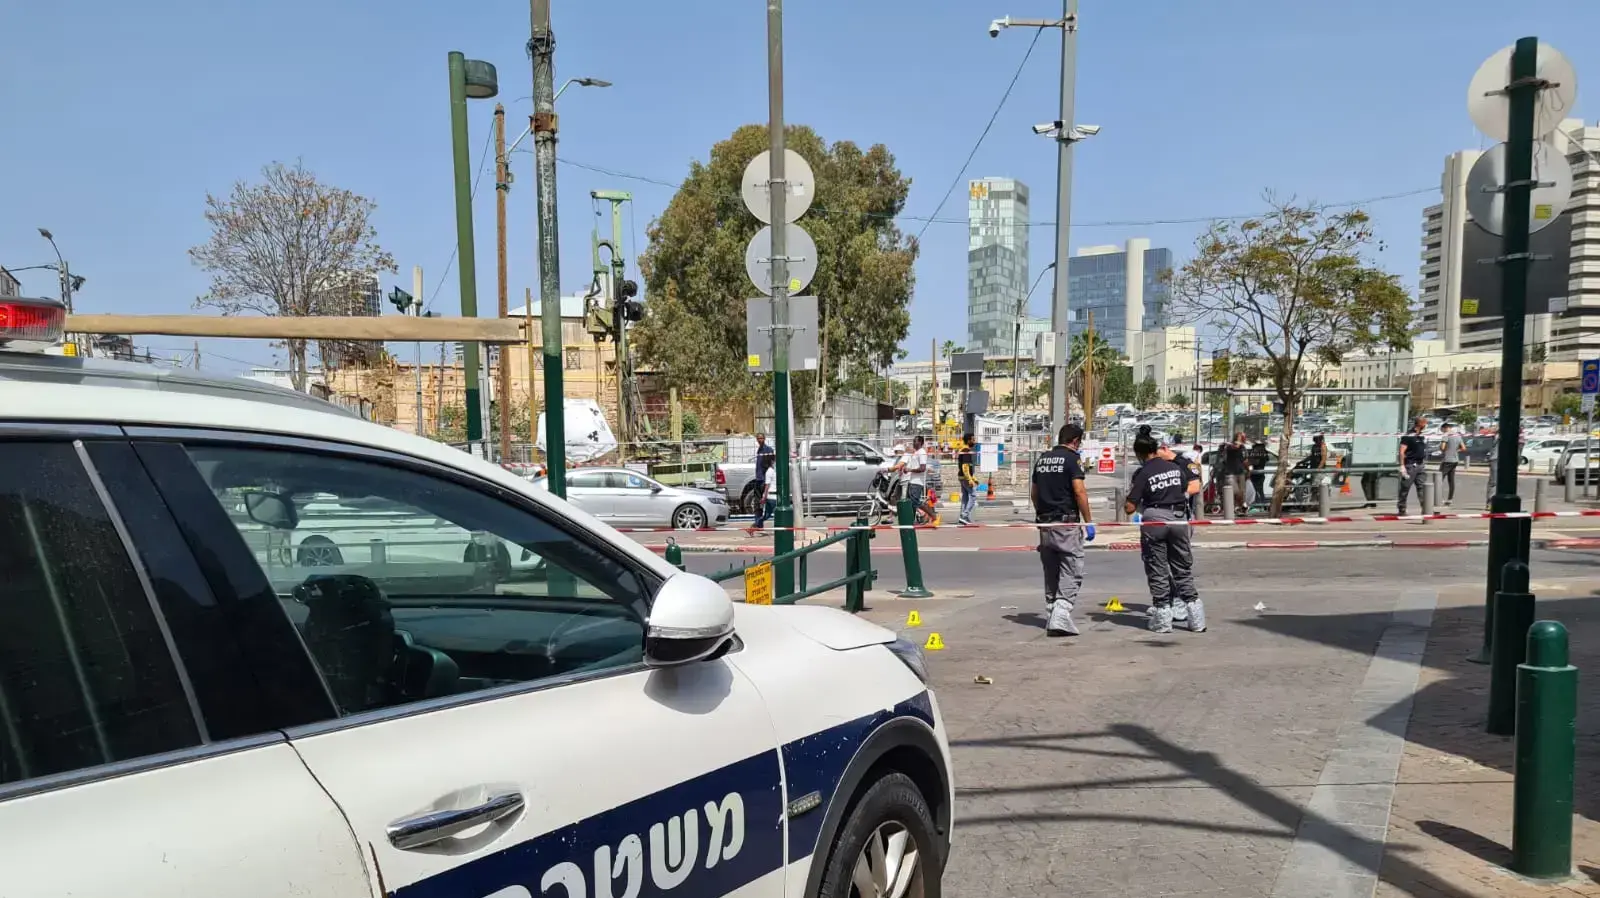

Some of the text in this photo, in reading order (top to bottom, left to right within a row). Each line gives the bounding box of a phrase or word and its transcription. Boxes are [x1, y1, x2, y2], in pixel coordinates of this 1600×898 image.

[1036, 465, 1064, 473] POLICE
[1148, 469, 1181, 485] משטרה
[481, 791, 745, 898] משטר
